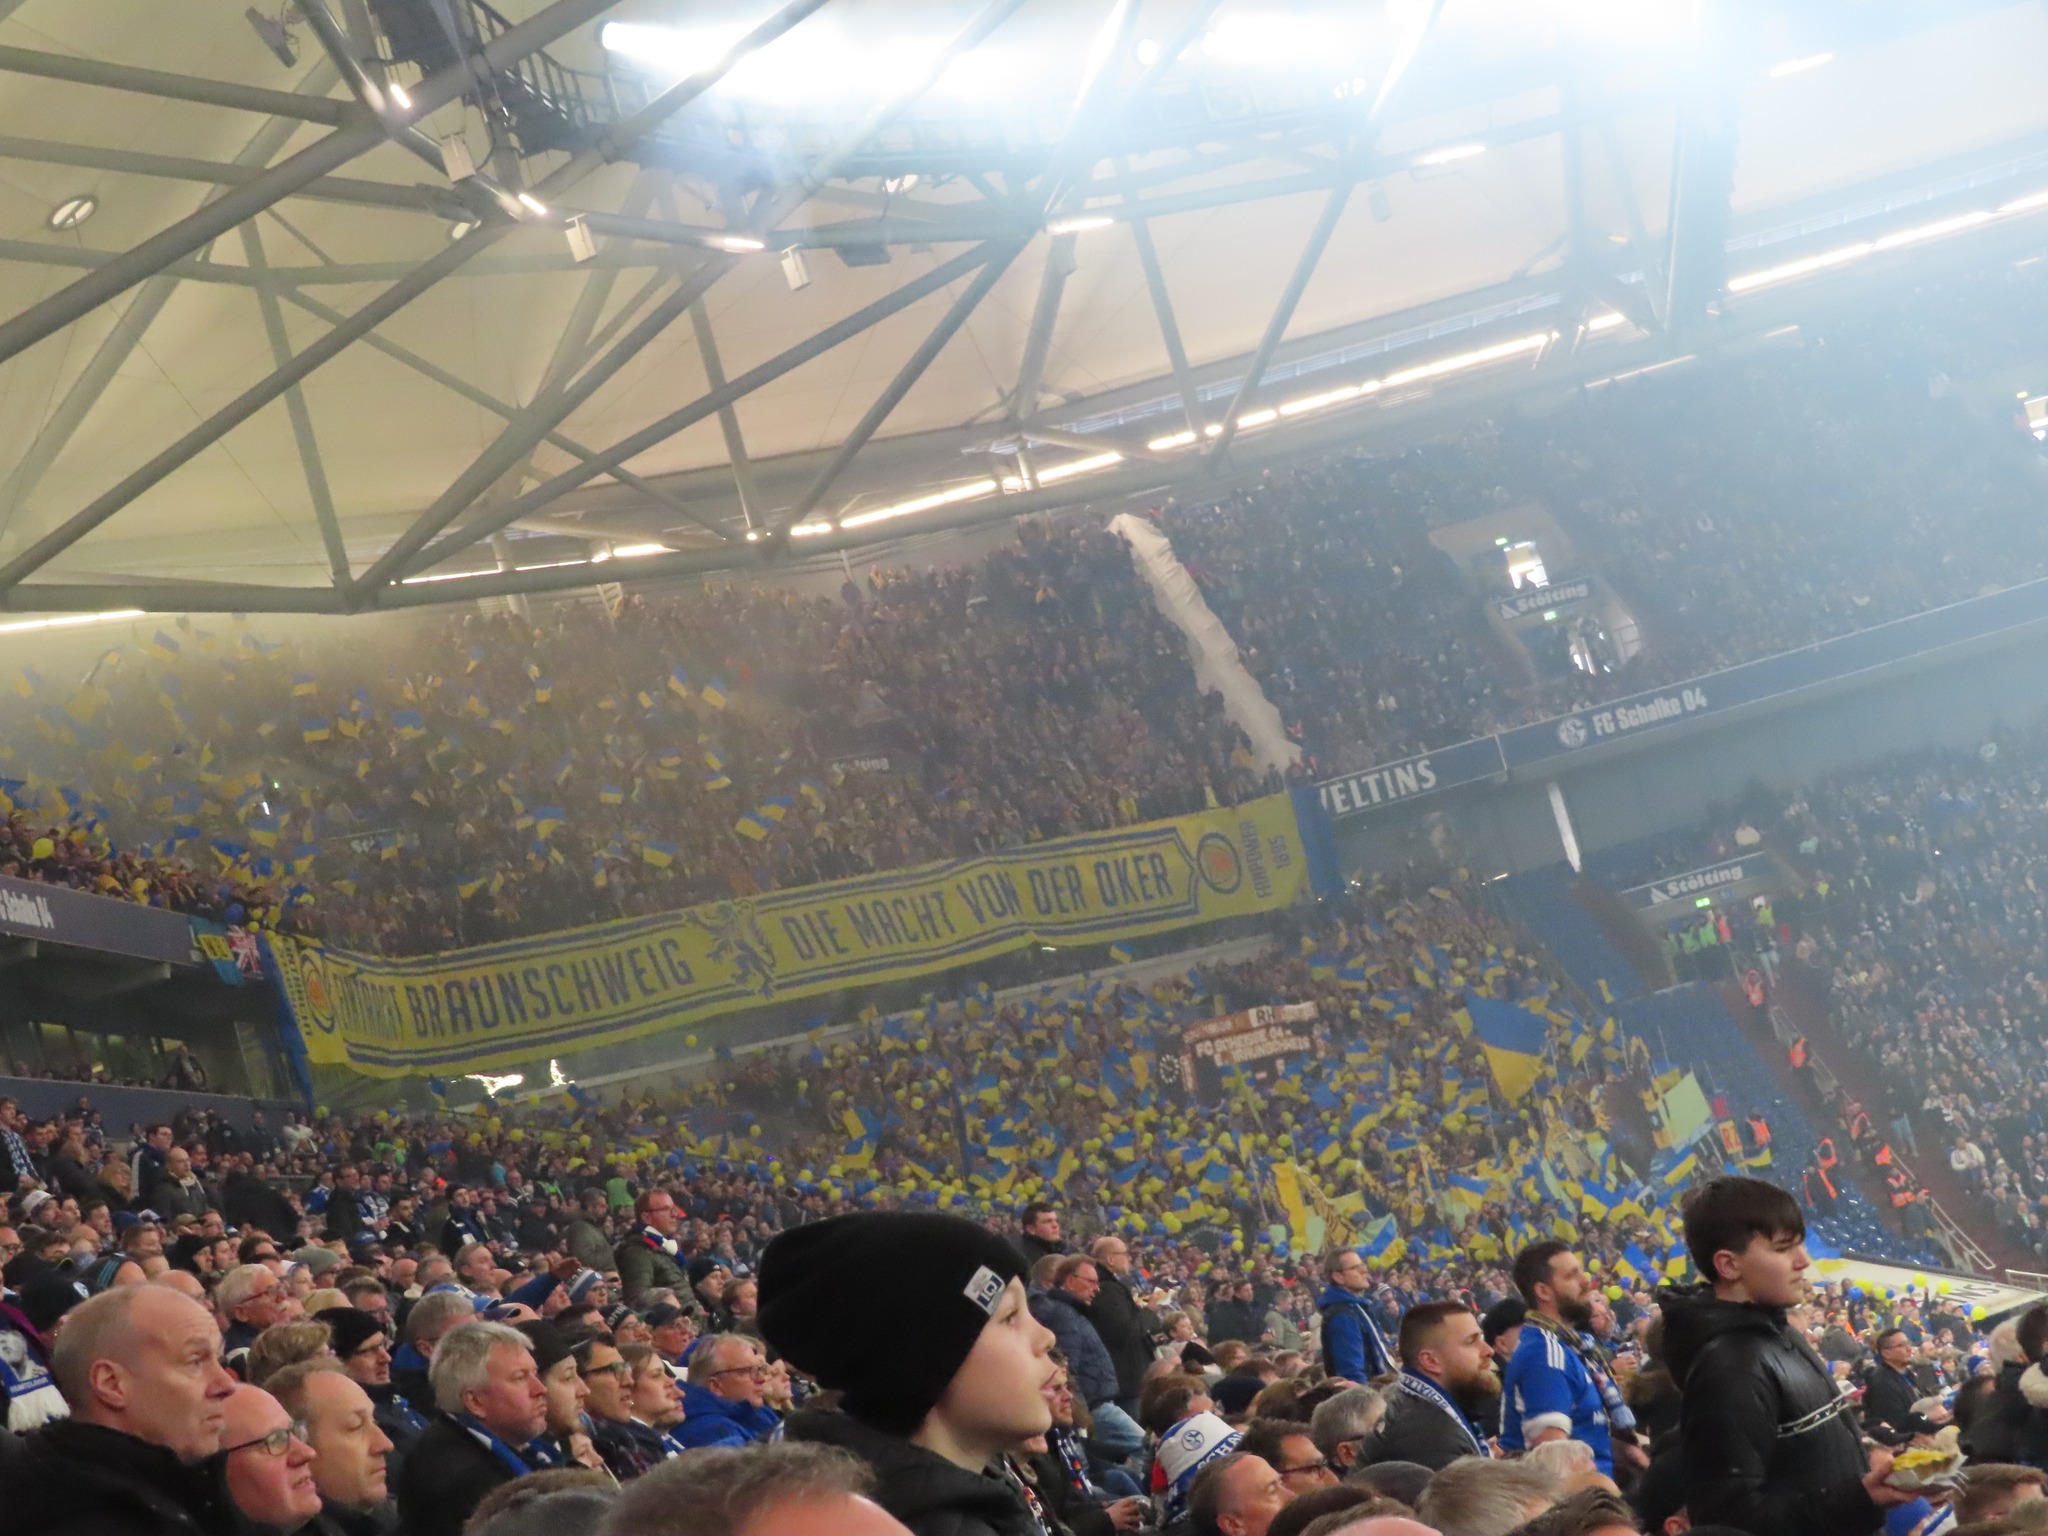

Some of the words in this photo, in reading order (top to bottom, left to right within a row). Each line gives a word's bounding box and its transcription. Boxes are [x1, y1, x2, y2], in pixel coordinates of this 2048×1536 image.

[1592, 712, 1616, 736] FC
[1615, 697, 1682, 730] Schalke
[1681, 687, 1708, 711] 04
[783, 910, 849, 961] DIE
[853, 887, 958, 946] MACHT
[957, 870, 1023, 924] VON
[1028, 860, 1083, 915] DER
[1094, 851, 1174, 908] OKER
[1666, 866, 1743, 896] Stölting
[405, 938, 694, 1039] BRAUNSCHWEIG
